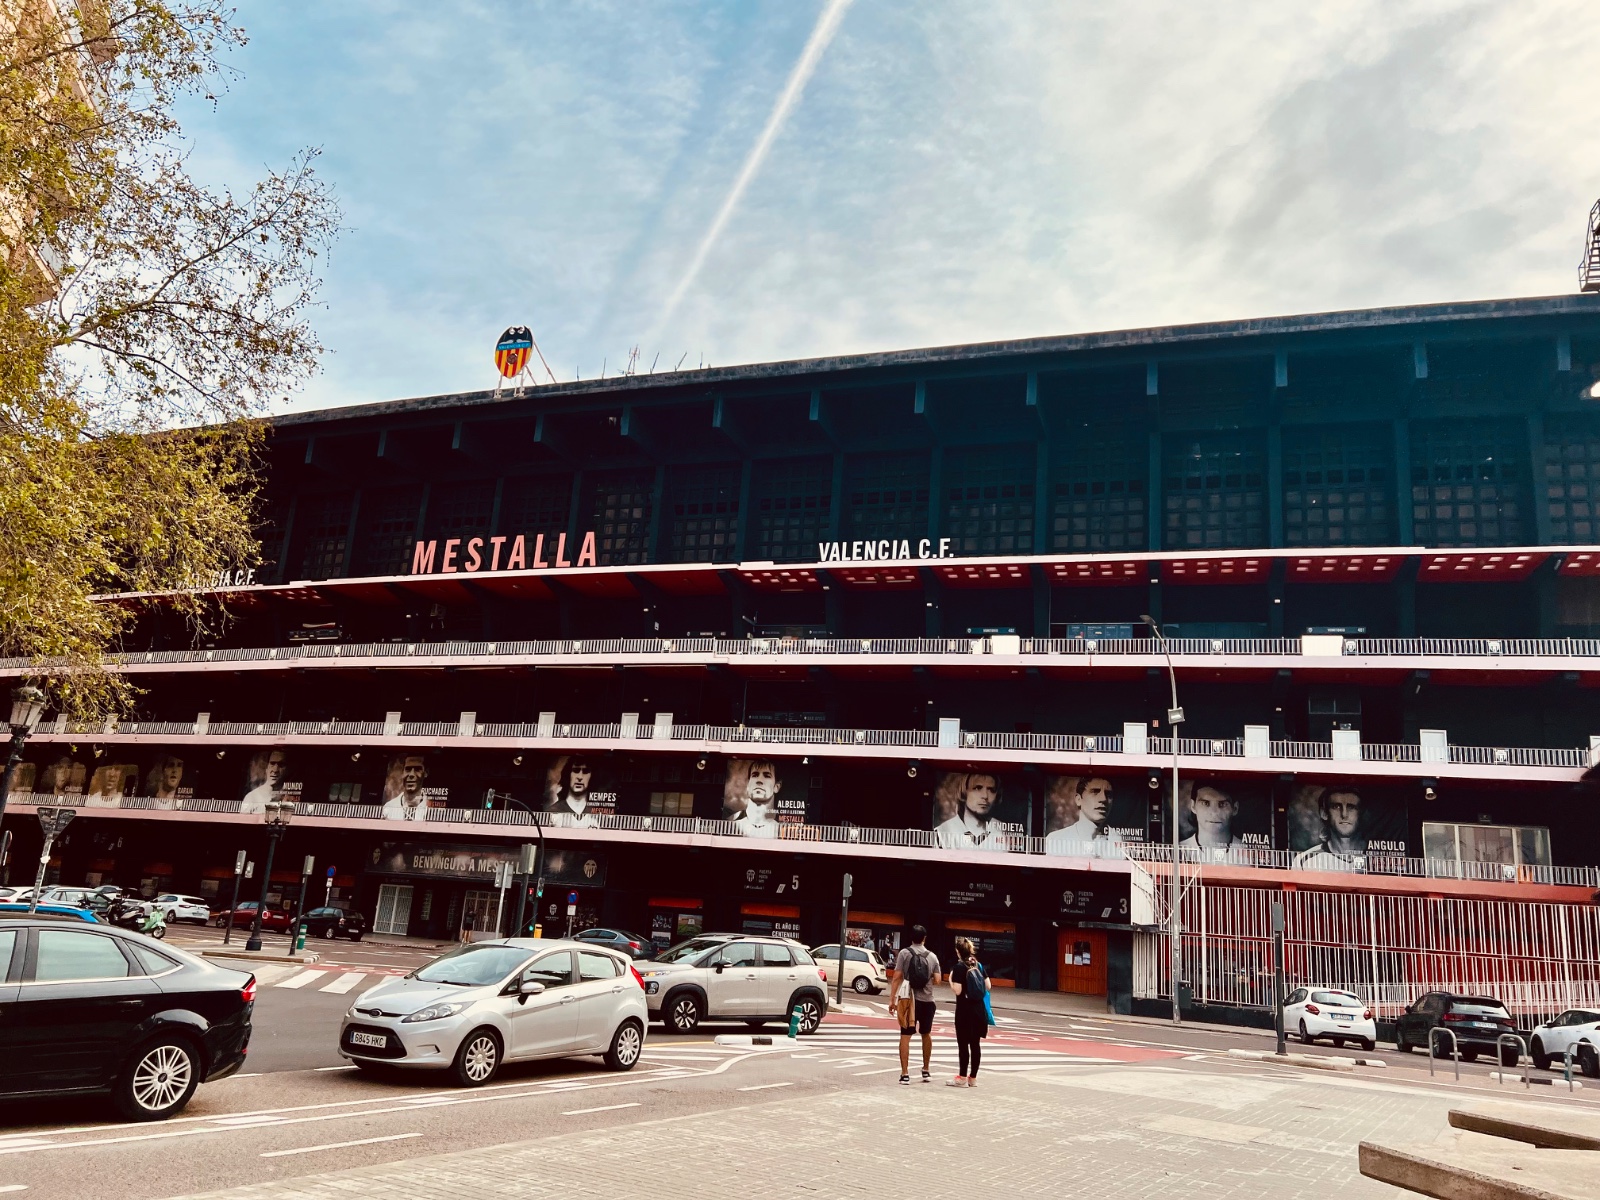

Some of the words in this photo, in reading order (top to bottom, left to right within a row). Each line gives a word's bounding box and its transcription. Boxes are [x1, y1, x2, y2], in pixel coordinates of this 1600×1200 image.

[411, 531, 597, 575] MESTALLA
[818, 539, 911, 562] VALENCIA
[918, 537, 955, 559] C.F.
[180, 570, 231, 588] LENCIA
[235, 569, 256, 586] C.F.
[282, 782, 303, 791] MUNDO
[588, 792, 617, 802] KEMPES
[777, 800, 805, 809] ALBELDA
[591, 807, 615, 815] MESTALLA
[779, 815, 805, 823] MESTALLA
[985, 821, 1025, 833] MENDIETA
[1241, 833, 1270, 845] AYALA
[1367, 840, 1406, 852] ANGULO
[469, 858, 475, 872] A
[791, 875, 799, 890] 5
[1119, 898, 1128, 914] 3
[782, 922, 792, 930] AÑO
[771, 930, 800, 939] CENTENARI
[371, 1036, 384, 1047] HKC
